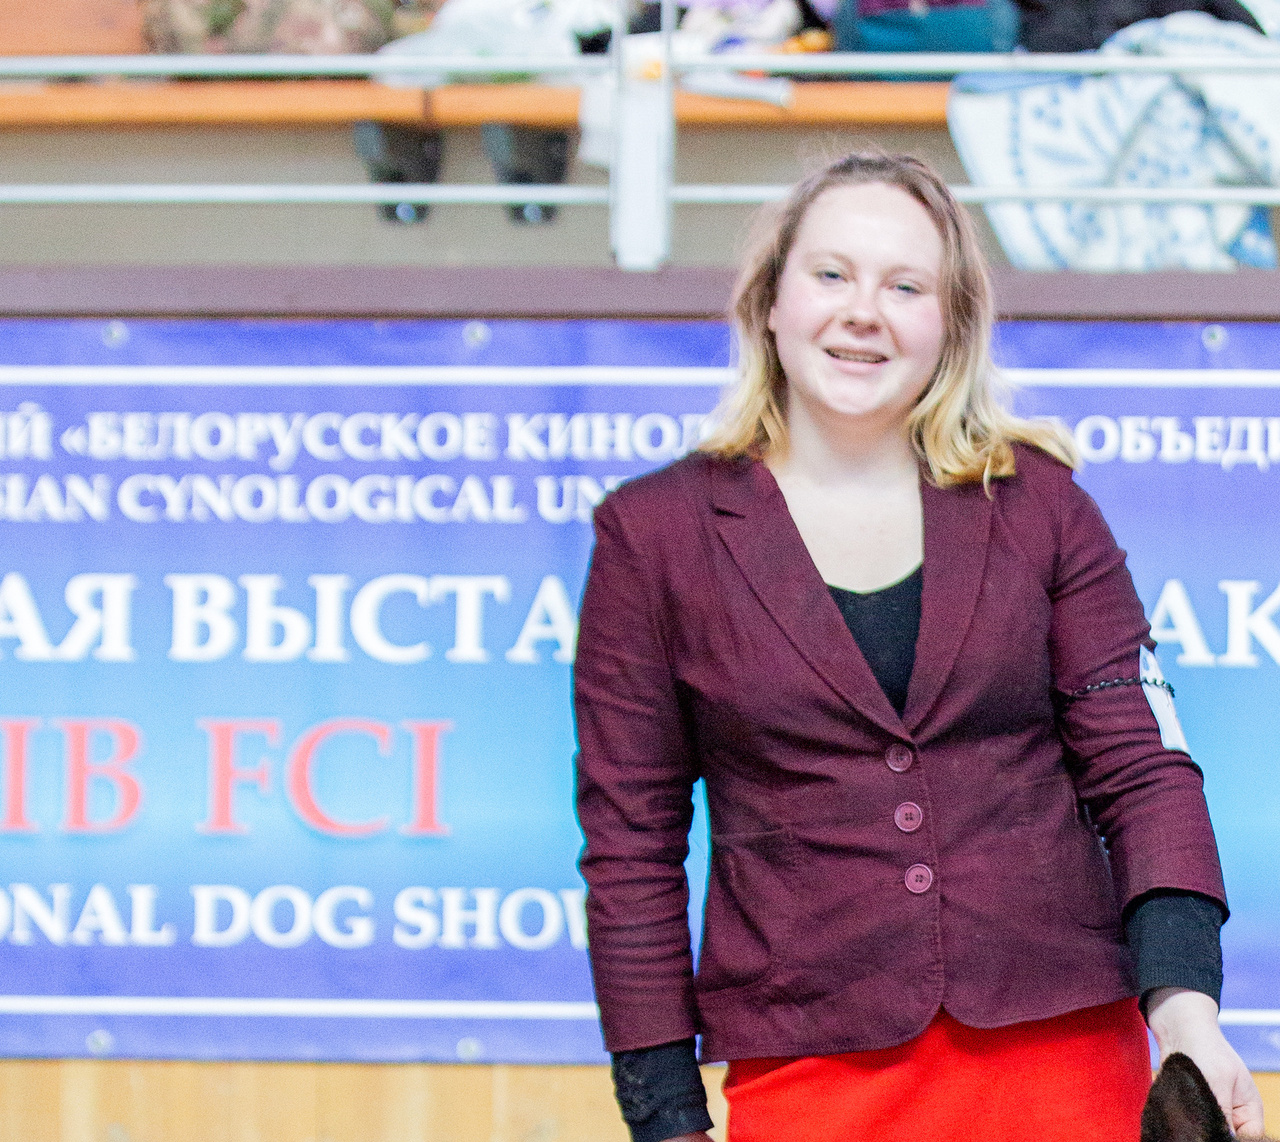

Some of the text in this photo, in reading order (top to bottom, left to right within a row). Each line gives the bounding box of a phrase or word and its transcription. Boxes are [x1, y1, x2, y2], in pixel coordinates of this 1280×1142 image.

[0, 401, 52, 460] Й
[61, 410, 498, 472] «БЕЛОРУССКОЕ
[0, 473, 110, 522] IAN
[117, 473, 526, 523] CYNOLOGICAL
[165, 572, 578, 664] ВЫСТА
[0, 717, 455, 838] IB FCI
[0, 883, 178, 946] NAL
[192, 884, 375, 949] DOG
